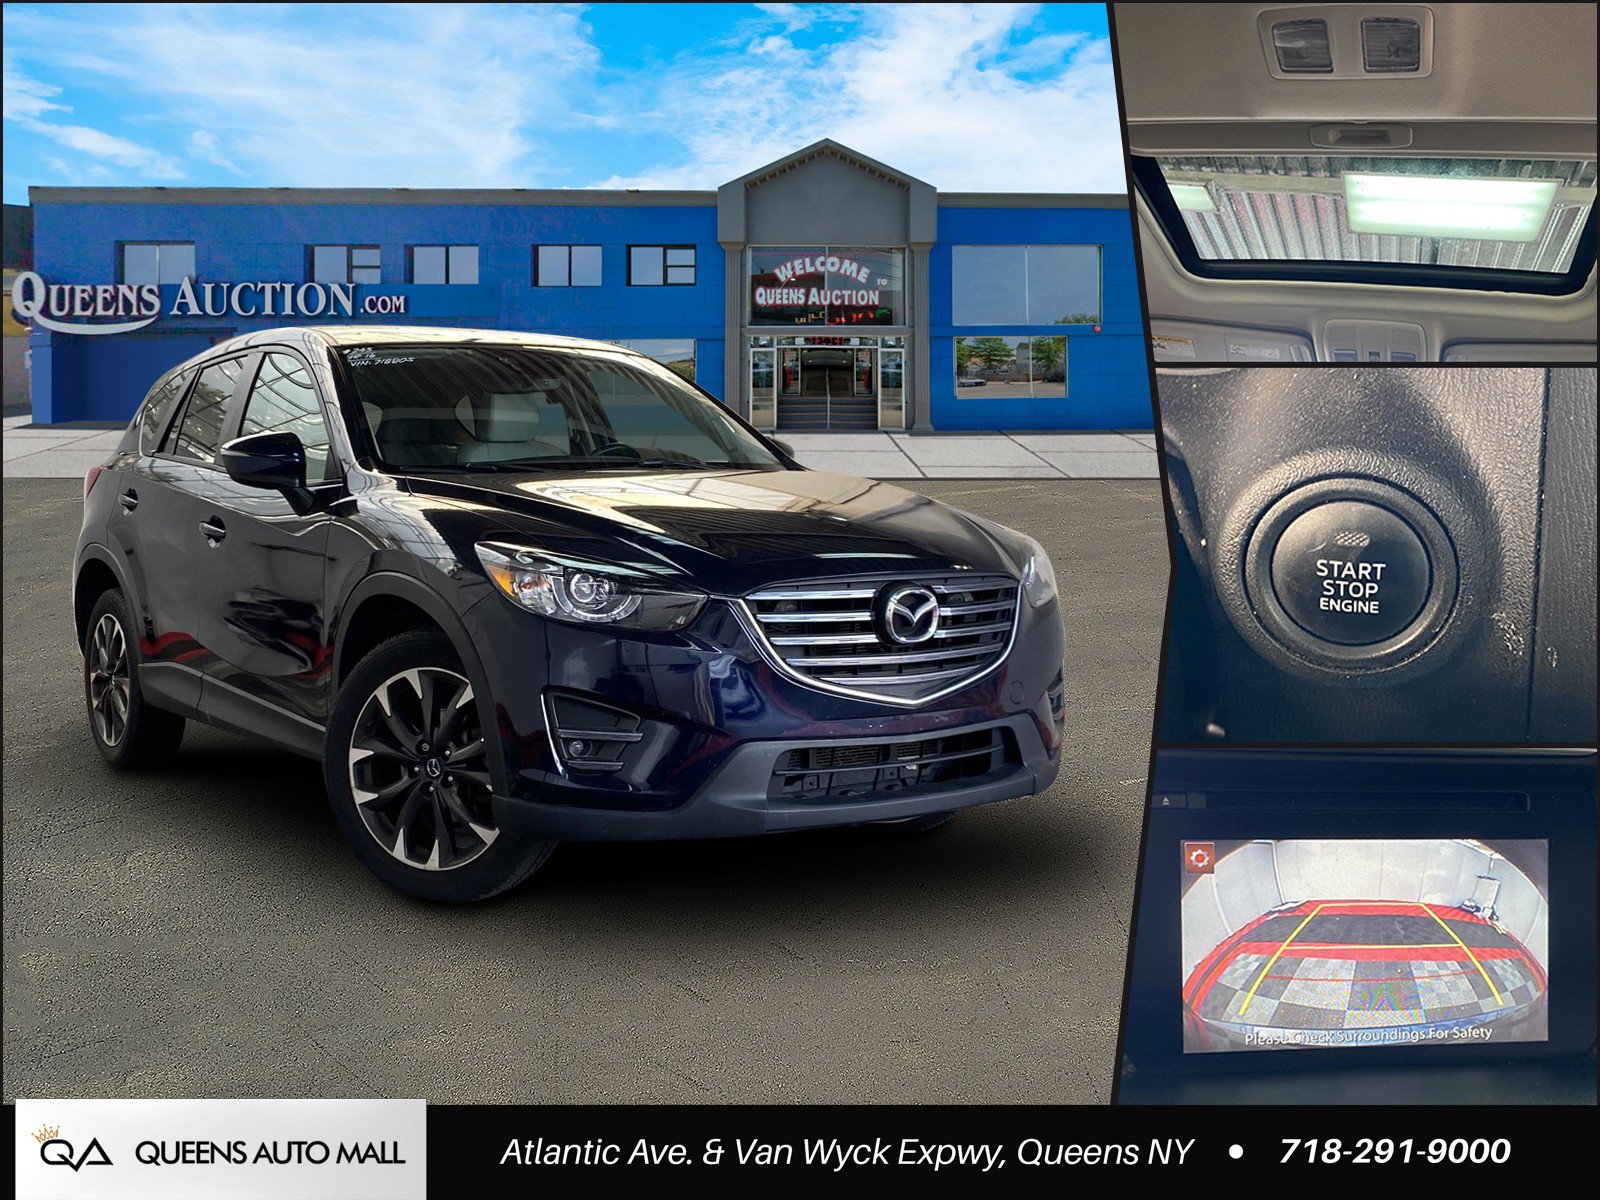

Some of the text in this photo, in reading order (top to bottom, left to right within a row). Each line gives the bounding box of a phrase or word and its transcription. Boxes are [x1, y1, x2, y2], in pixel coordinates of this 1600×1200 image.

[773, 255, 872, 284] WELCOME
[11, 271, 162, 335] QUEENS
[169, 276, 356, 317] AUCTION
[754, 286, 880, 307] QUEENS AUCTION
[1316, 559, 1387, 580] START
[1322, 580, 1379, 599] STOP
[1320, 597, 1379, 614] ENGINE
[1245, 1026, 1493, 1046] Please Check Surroundings For Safety
